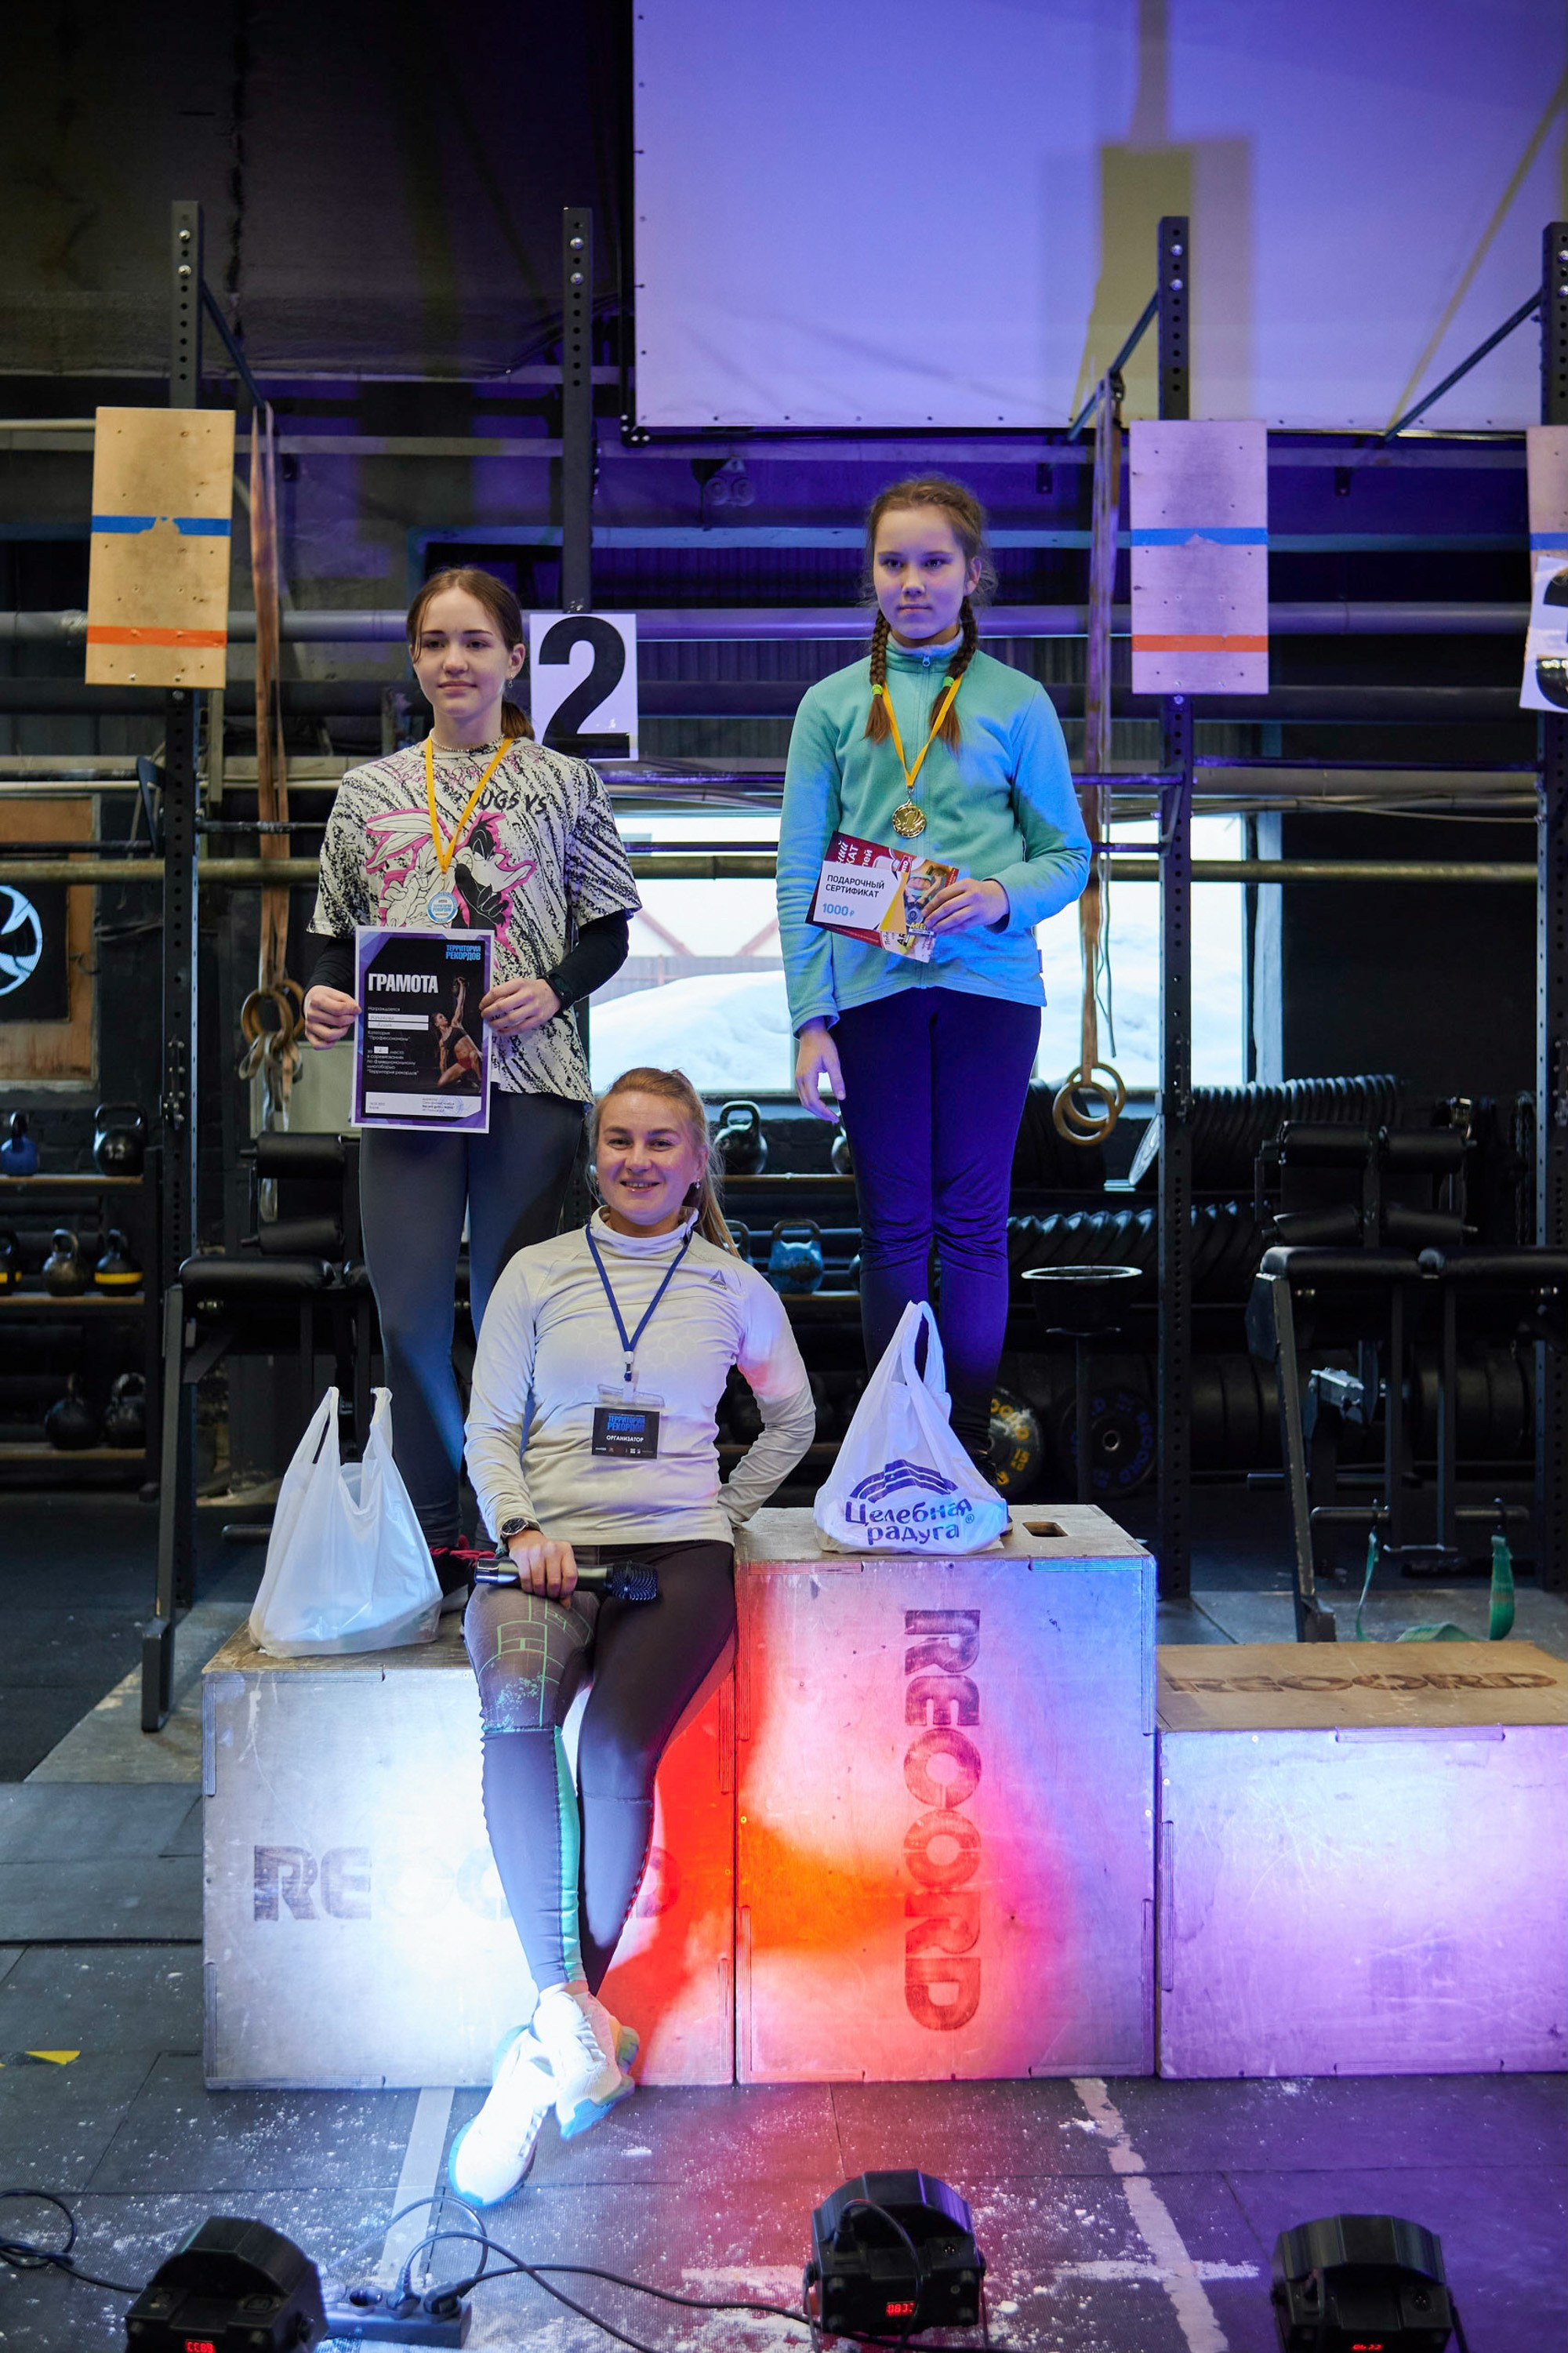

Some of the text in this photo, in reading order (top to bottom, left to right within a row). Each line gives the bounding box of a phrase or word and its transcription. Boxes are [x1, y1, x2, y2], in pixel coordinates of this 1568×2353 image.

[539, 615, 630, 759] 2
[826, 874, 885, 890] ПОДАРОЧНЫЙ
[826, 884, 879, 898] СЕРТИФИКАТ
[446, 952, 481, 960] РЕКОРДОВ
[368, 973, 438, 993] ГРАМОТА
[845, 1498, 972, 1527] Целебная
[867, 1523, 960, 1545] радуга
[1164, 1672, 1557, 1693] RECORD
[903, 1610, 982, 2032] RECORD
